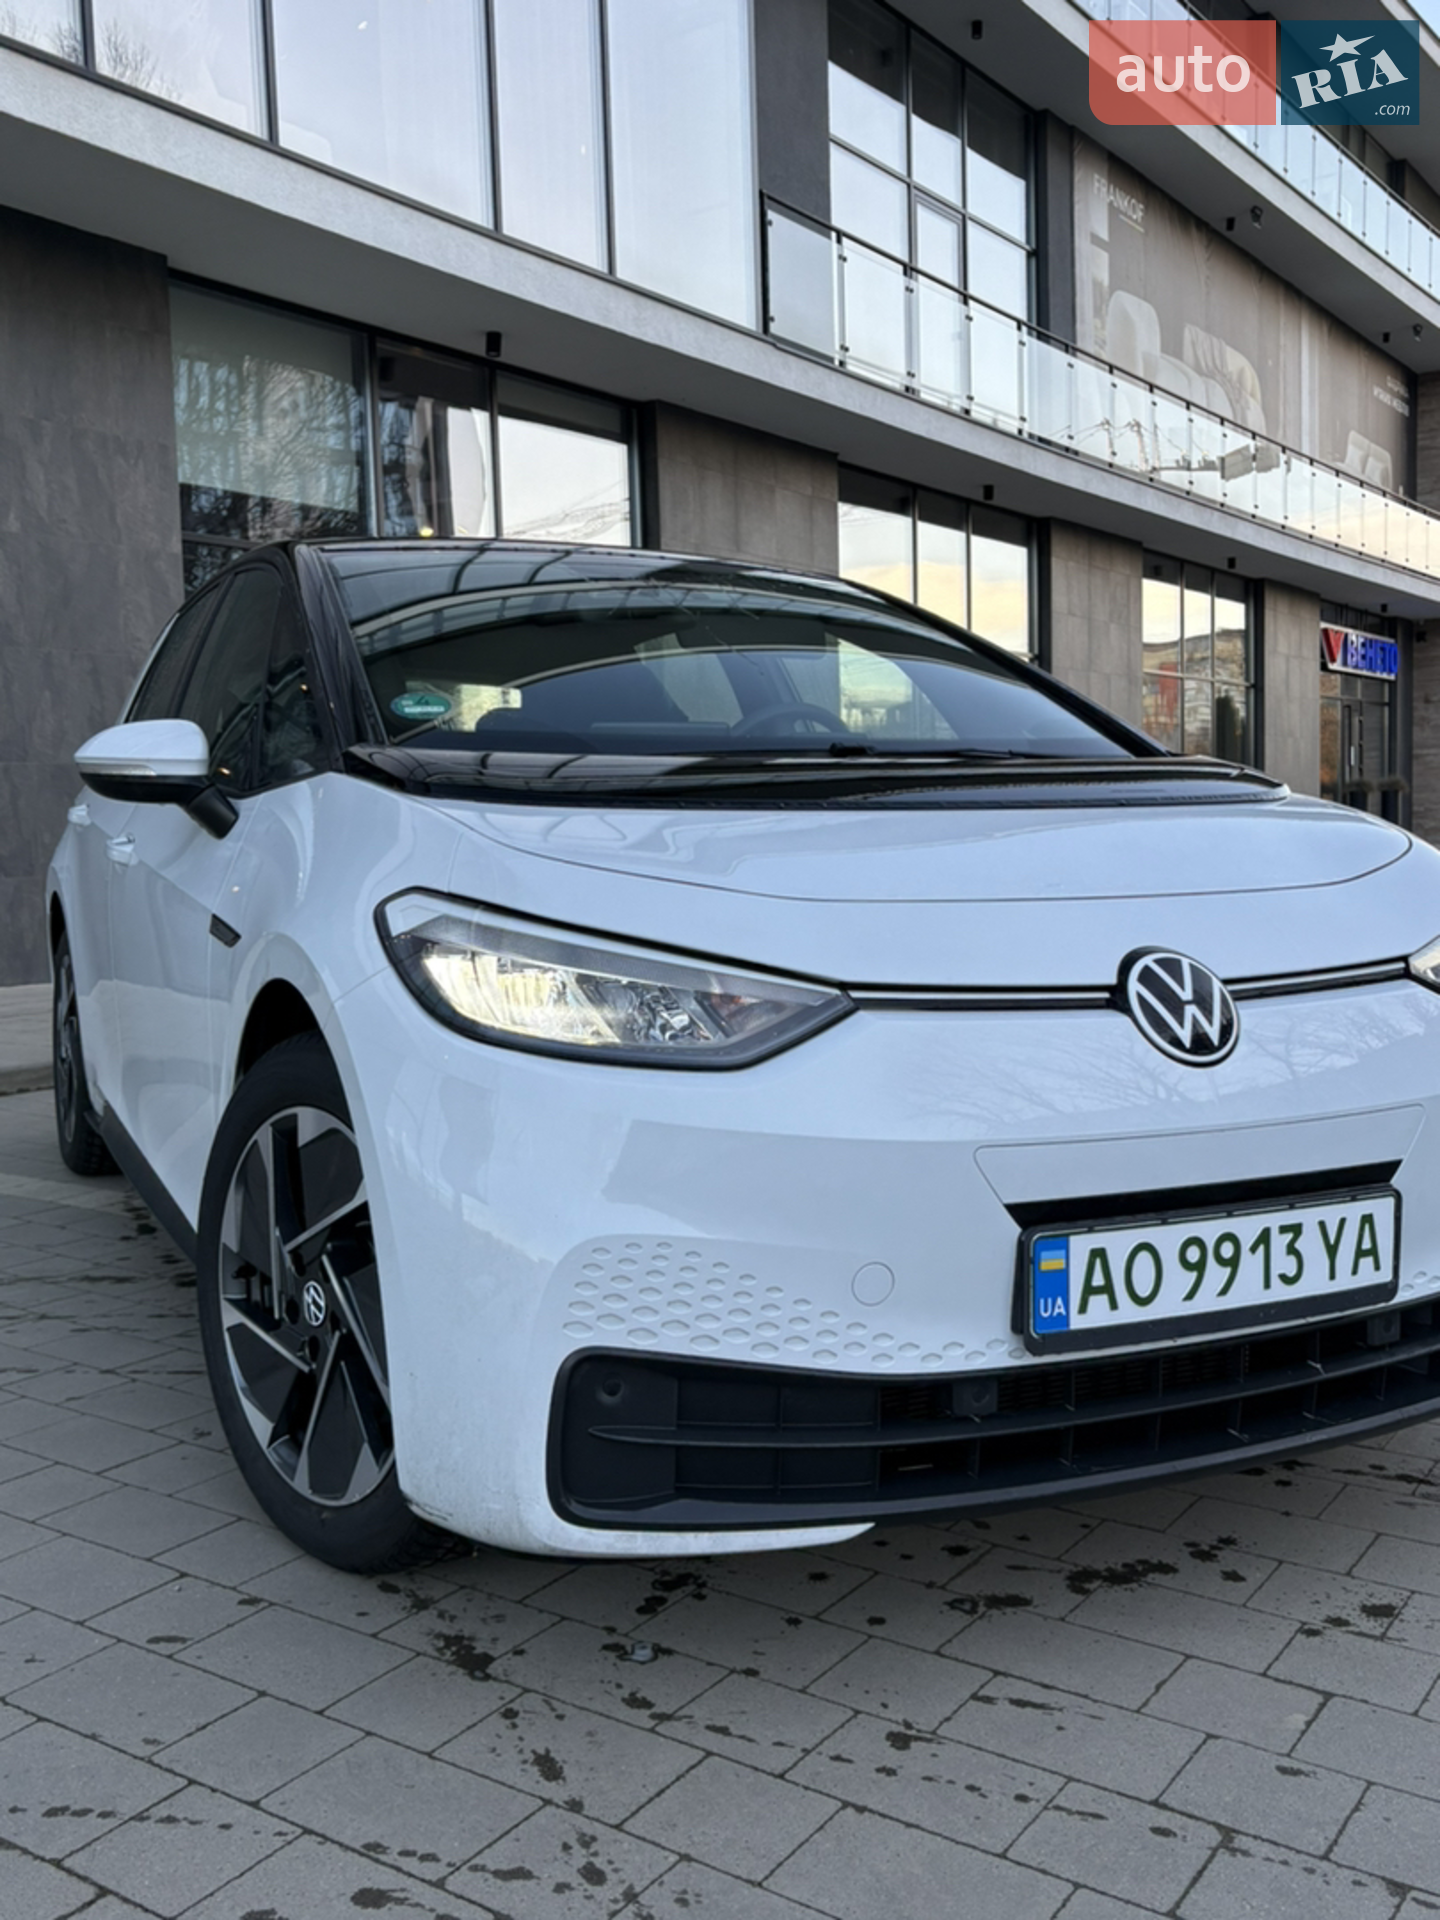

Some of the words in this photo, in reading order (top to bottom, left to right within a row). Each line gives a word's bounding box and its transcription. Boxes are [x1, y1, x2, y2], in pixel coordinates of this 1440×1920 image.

[1077, 1241, 1164, 1315] AO
[1178, 1222, 1304, 1303] 9913
[1317, 1212, 1382, 1282] YA
[1039, 1298, 1067, 1318] UA
